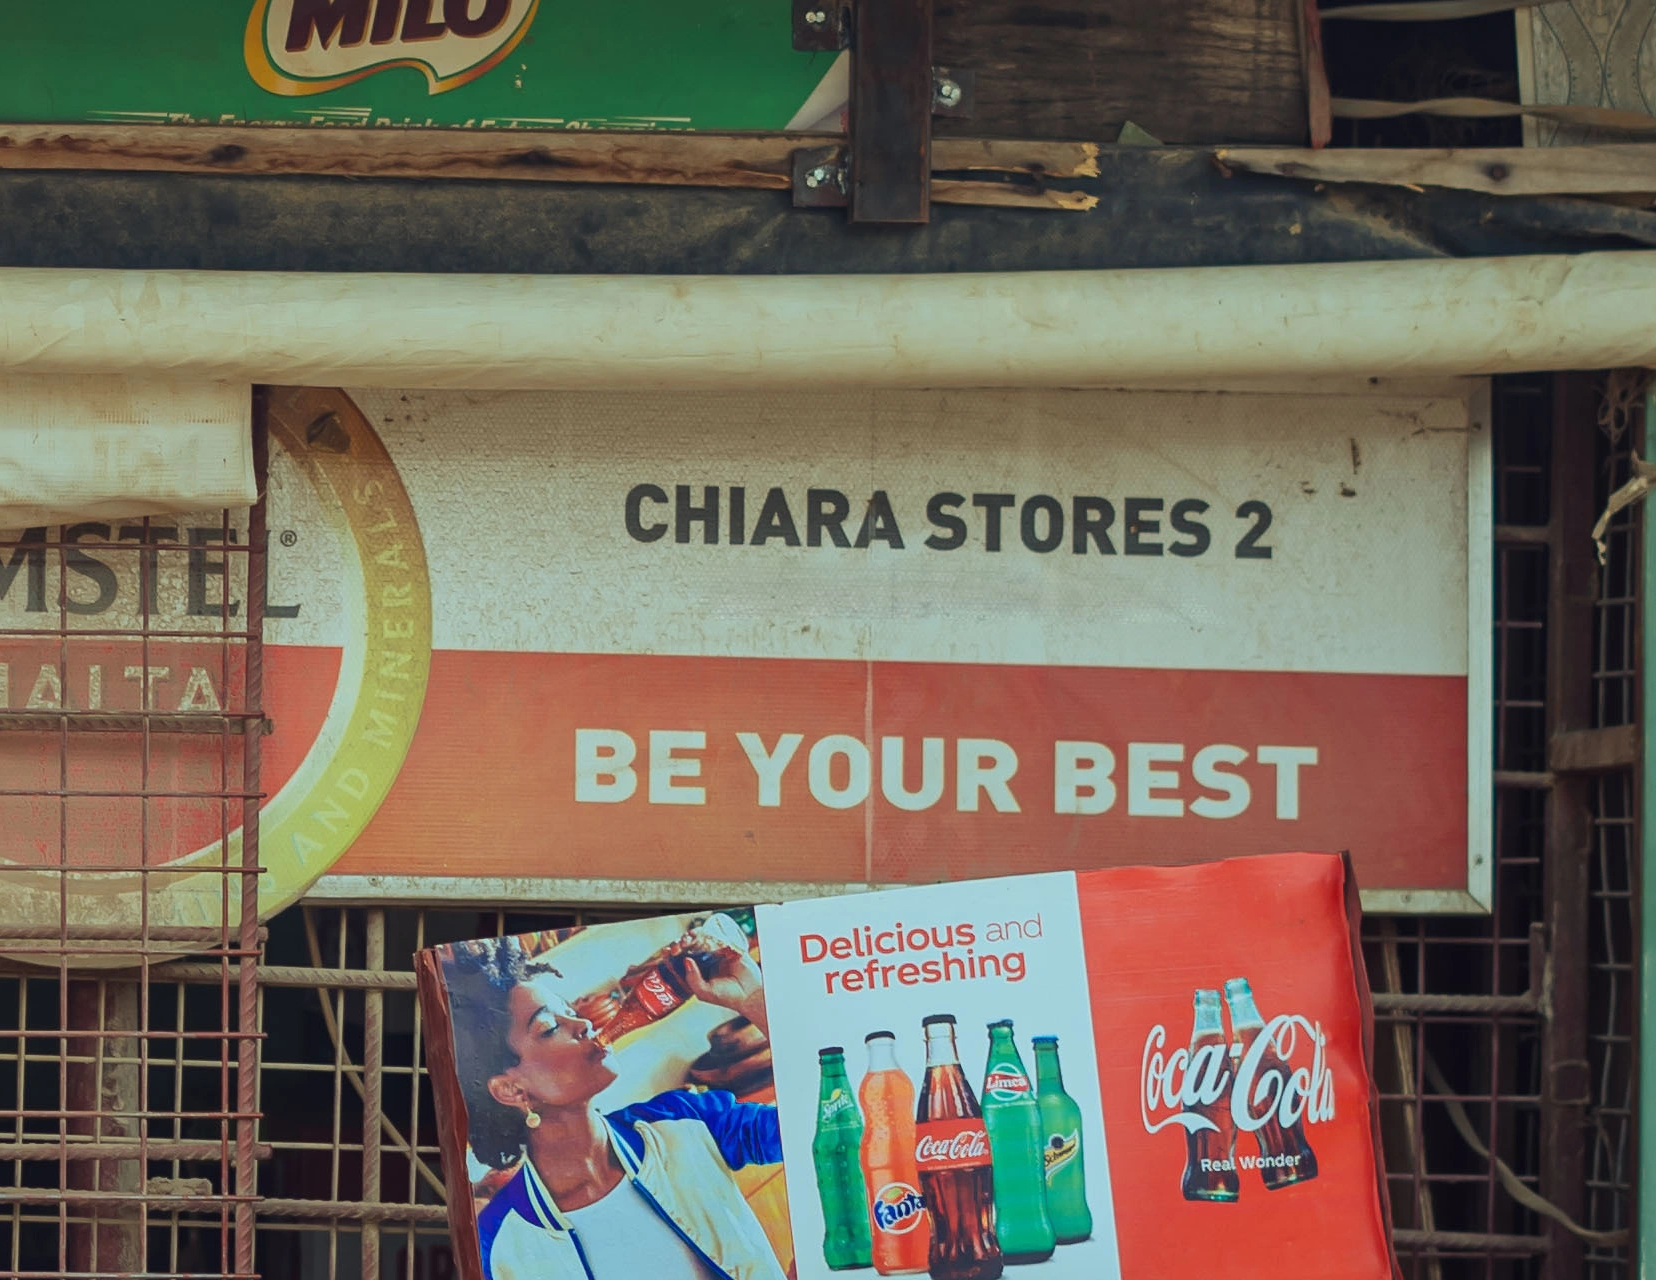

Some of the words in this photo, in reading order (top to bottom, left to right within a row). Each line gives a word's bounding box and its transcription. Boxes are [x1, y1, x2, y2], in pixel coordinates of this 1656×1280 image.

[624, 482, 905, 551] CHIARA
[924, 491, 1213, 558] STORES
[1234, 499, 1274, 561] 2
[352, 477, 415, 749] MINERALS
[574, 728, 707, 806] BE
[735, 732, 1023, 815] YOUR
[1053, 739, 1319, 822] BEST
[291, 767, 371, 868] AND
[799, 923, 976, 965] Delicious
[986, 913, 1044, 945] and
[824, 947, 1028, 996] refreshing
[987, 1074, 1028, 1090] Limca
[1141, 1014, 1336, 1135] Coca-Cola
[915, 1130, 987, 1164] Coca-Cola
[1201, 1154, 1236, 1173] Real
[1239, 1152, 1301, 1171] Wonder
[873, 1192, 928, 1232] Fanta
